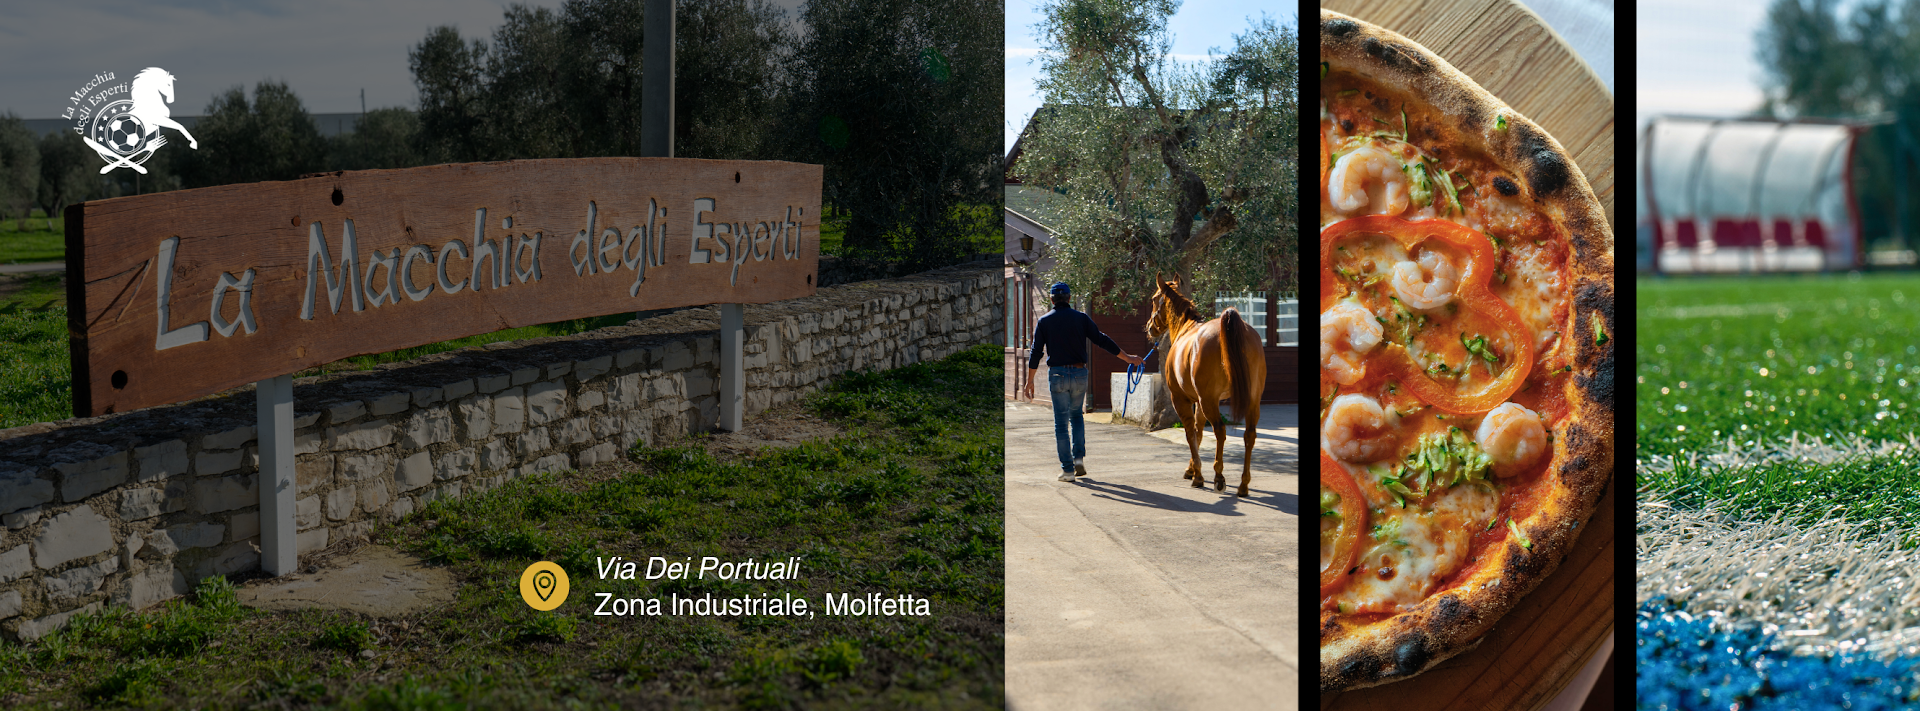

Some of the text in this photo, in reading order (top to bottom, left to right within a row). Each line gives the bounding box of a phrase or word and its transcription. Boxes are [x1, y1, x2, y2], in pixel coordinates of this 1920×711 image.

[156, 197, 803, 351] La Macchia degli Esperti
